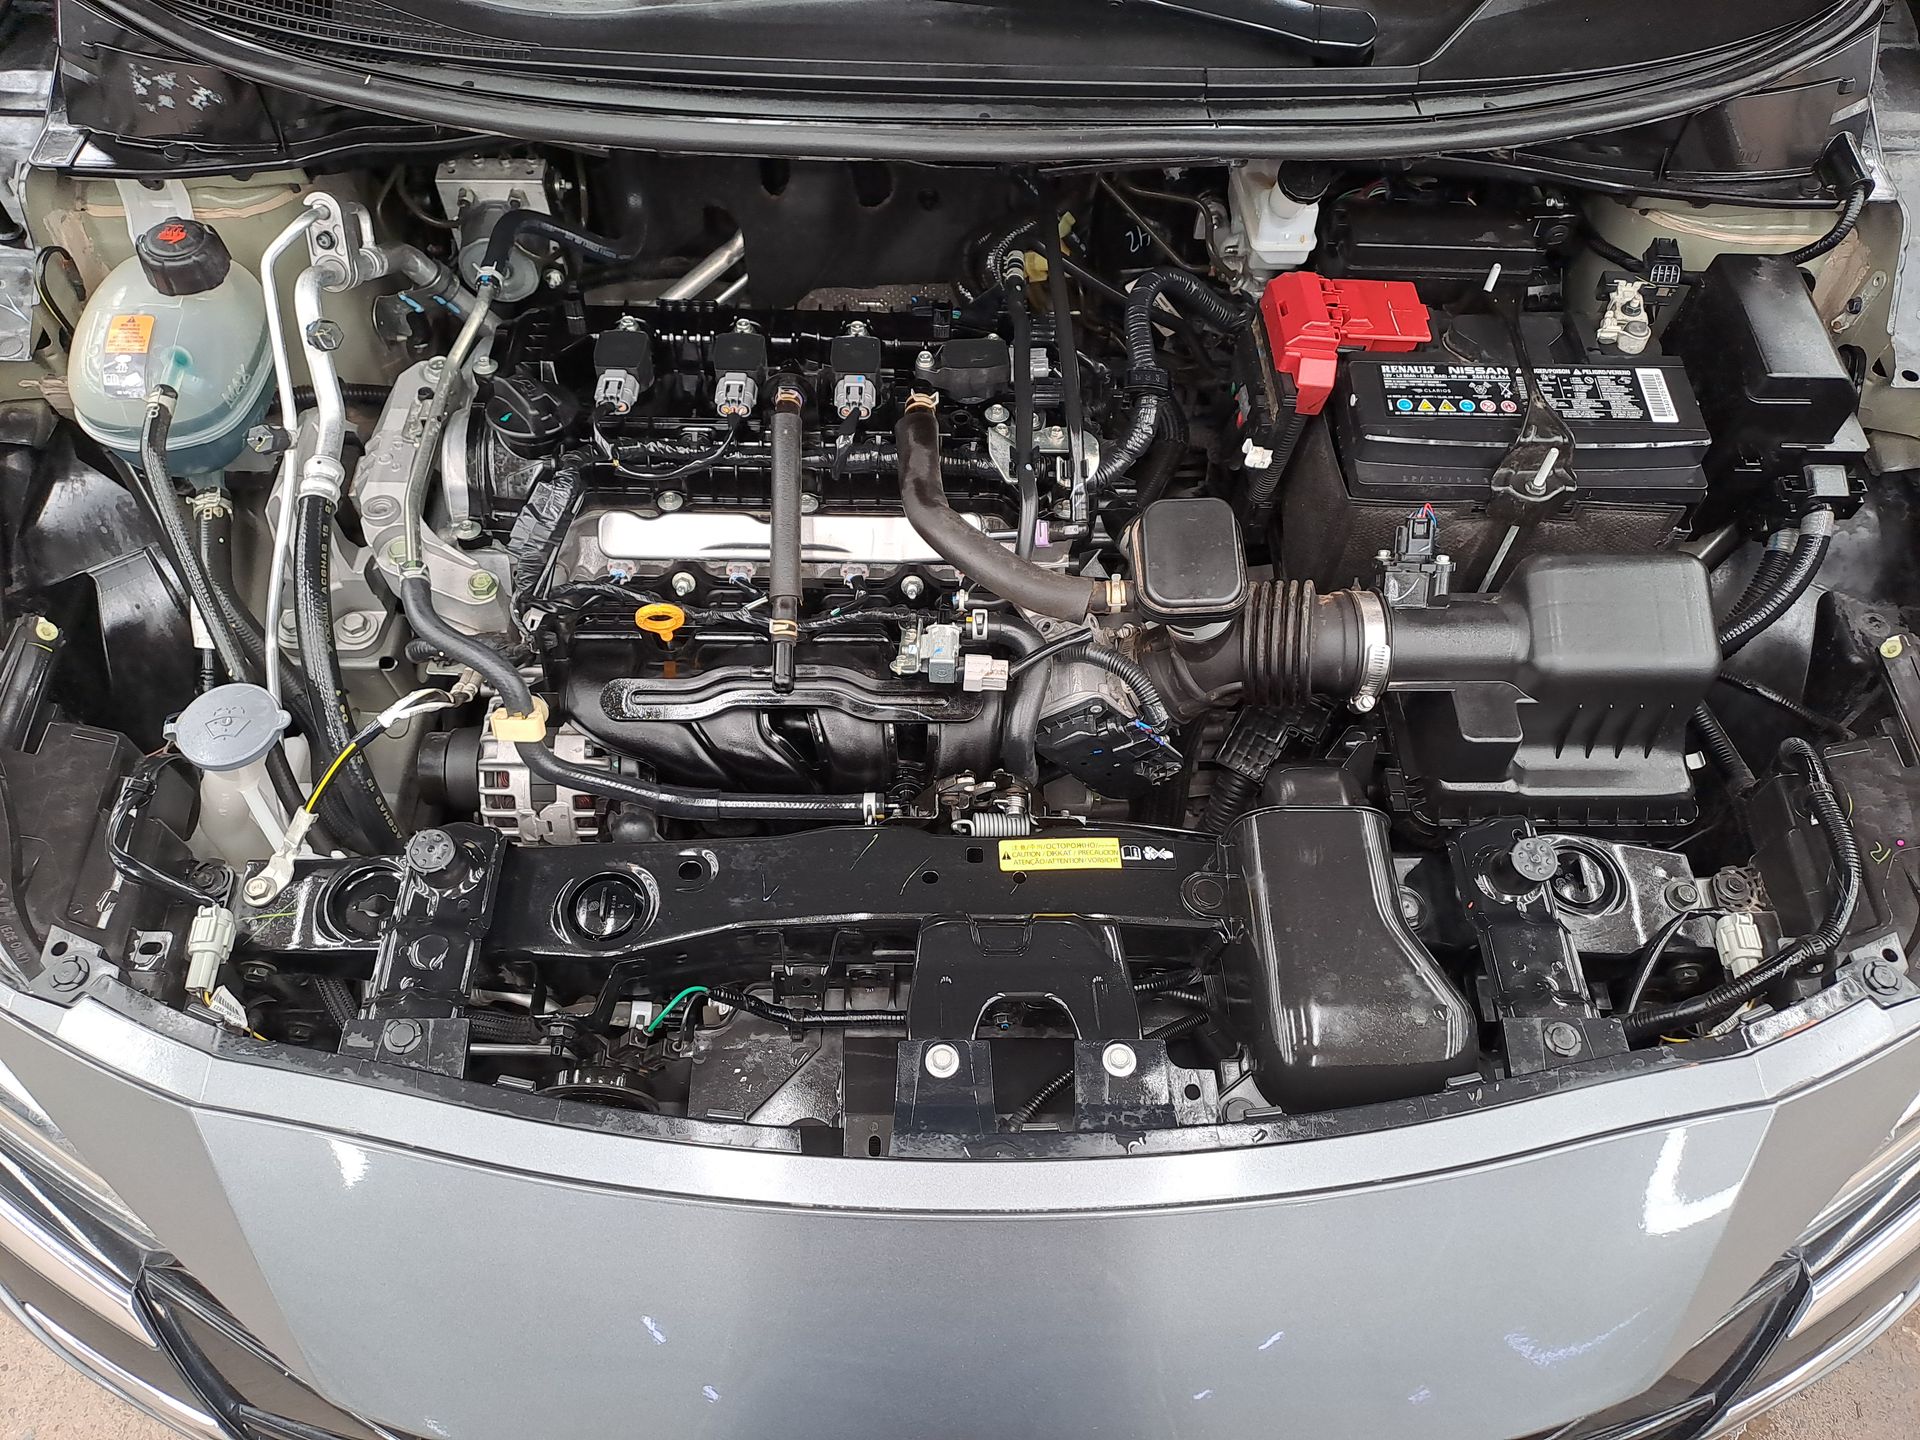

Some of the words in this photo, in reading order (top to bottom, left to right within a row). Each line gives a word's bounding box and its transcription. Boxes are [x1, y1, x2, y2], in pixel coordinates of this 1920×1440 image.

[1381, 365, 1436, 374] RENAULT
[1448, 366, 1509, 375] NISSAN
[1012, 850, 1041, 858] CAUTION
